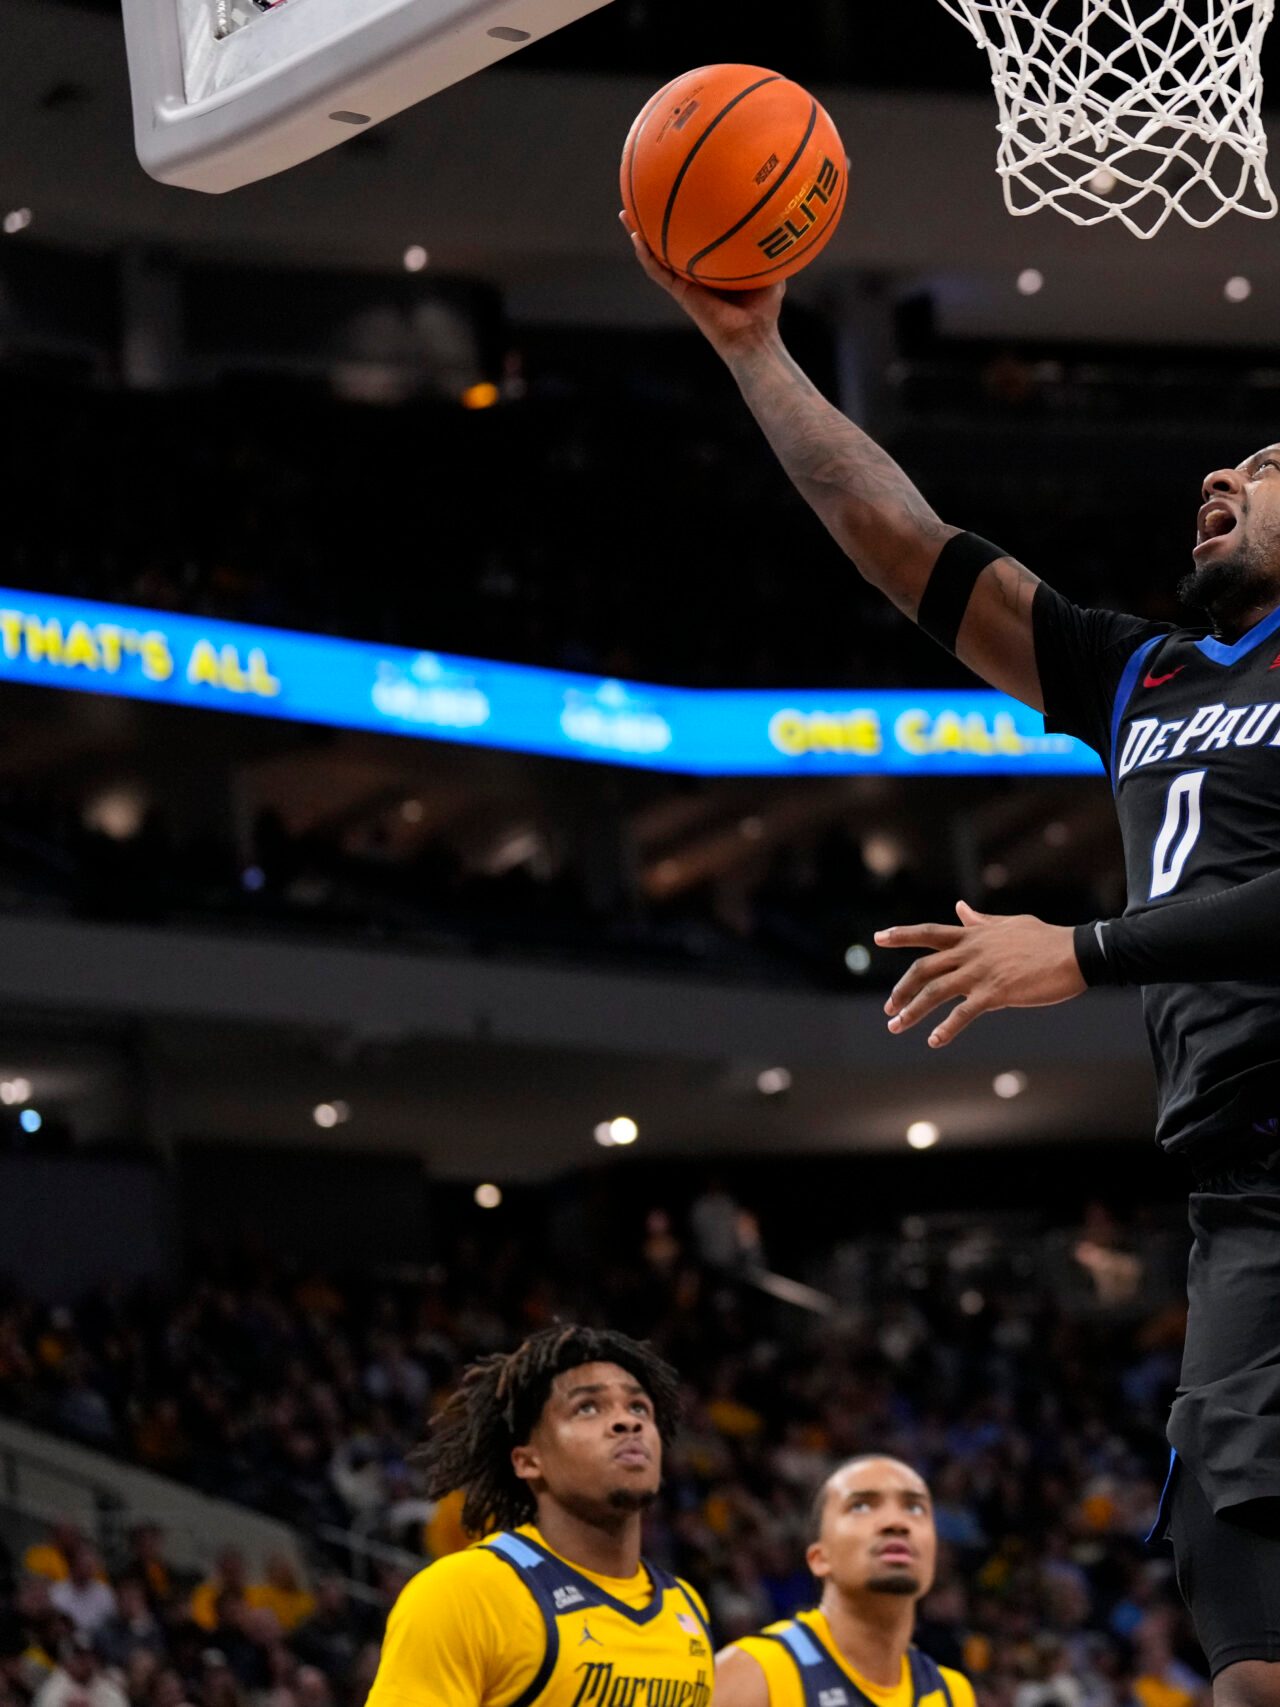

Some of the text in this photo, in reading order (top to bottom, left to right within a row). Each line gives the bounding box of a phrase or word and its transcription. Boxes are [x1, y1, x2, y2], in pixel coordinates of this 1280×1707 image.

[757, 157, 838, 259] ELITE
[0, 609, 281, 697] THAT'S ALL
[768, 709, 881, 756] ONE
[1148, 768, 1208, 901] 0
